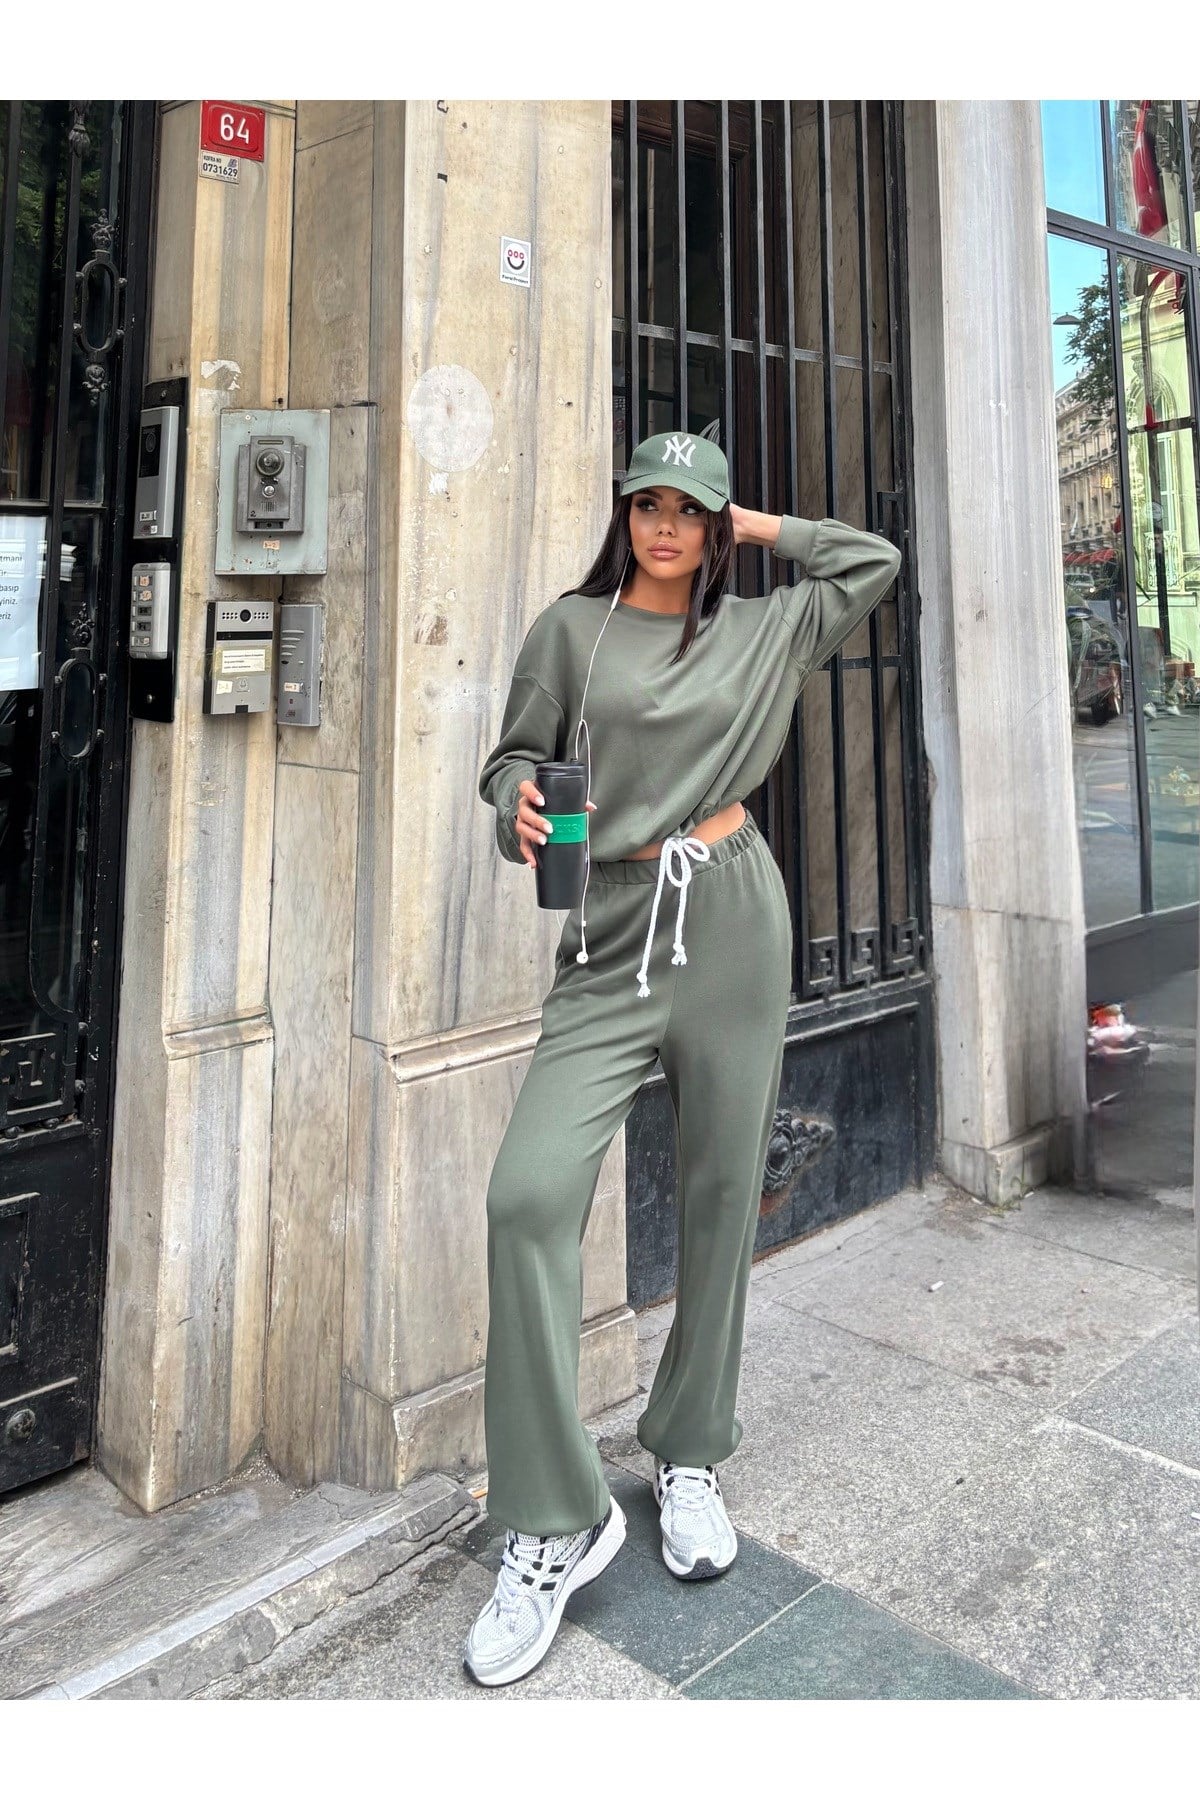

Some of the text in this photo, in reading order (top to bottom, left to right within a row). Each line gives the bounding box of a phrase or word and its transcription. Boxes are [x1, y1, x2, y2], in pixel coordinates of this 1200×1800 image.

[220, 112, 250, 144] 64
[202, 162, 238, 177] 0731629
[661, 435, 697, 468] NY
